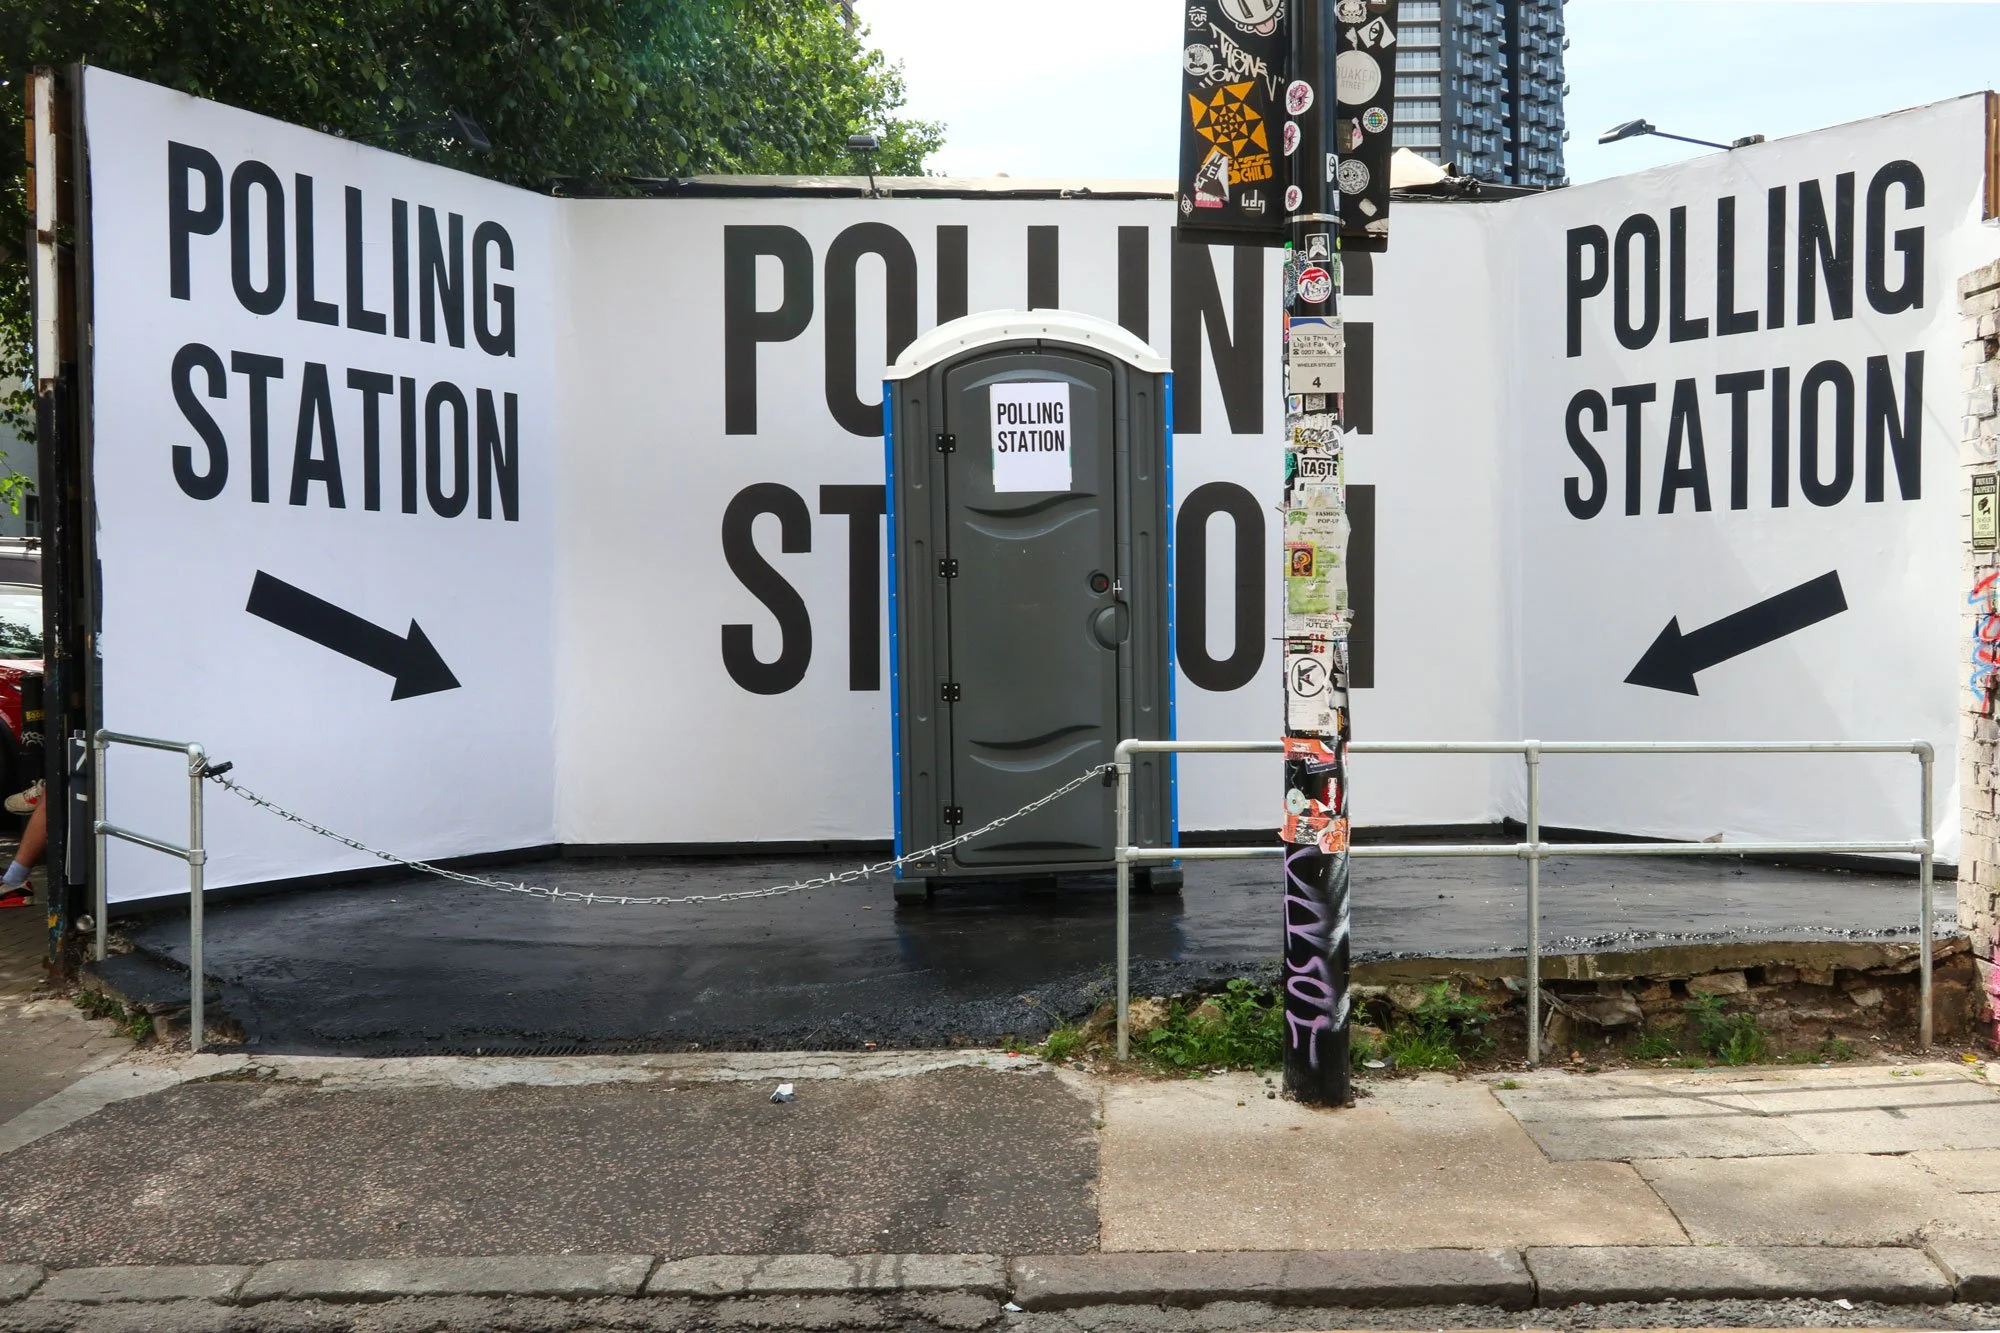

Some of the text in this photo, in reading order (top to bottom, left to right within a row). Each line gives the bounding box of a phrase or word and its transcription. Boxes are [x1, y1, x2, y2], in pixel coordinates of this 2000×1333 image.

[168, 140, 516, 358] POLLING
[1566, 160, 1925, 358] POLLING
[997, 402, 1064, 425] POLLING
[1312, 376, 1322, 388] 4
[171, 343, 519, 521] STATION
[997, 430, 1065, 453] STATION
[1303, 461, 1338, 476] TASTE
[1564, 350, 1925, 520] STATION
